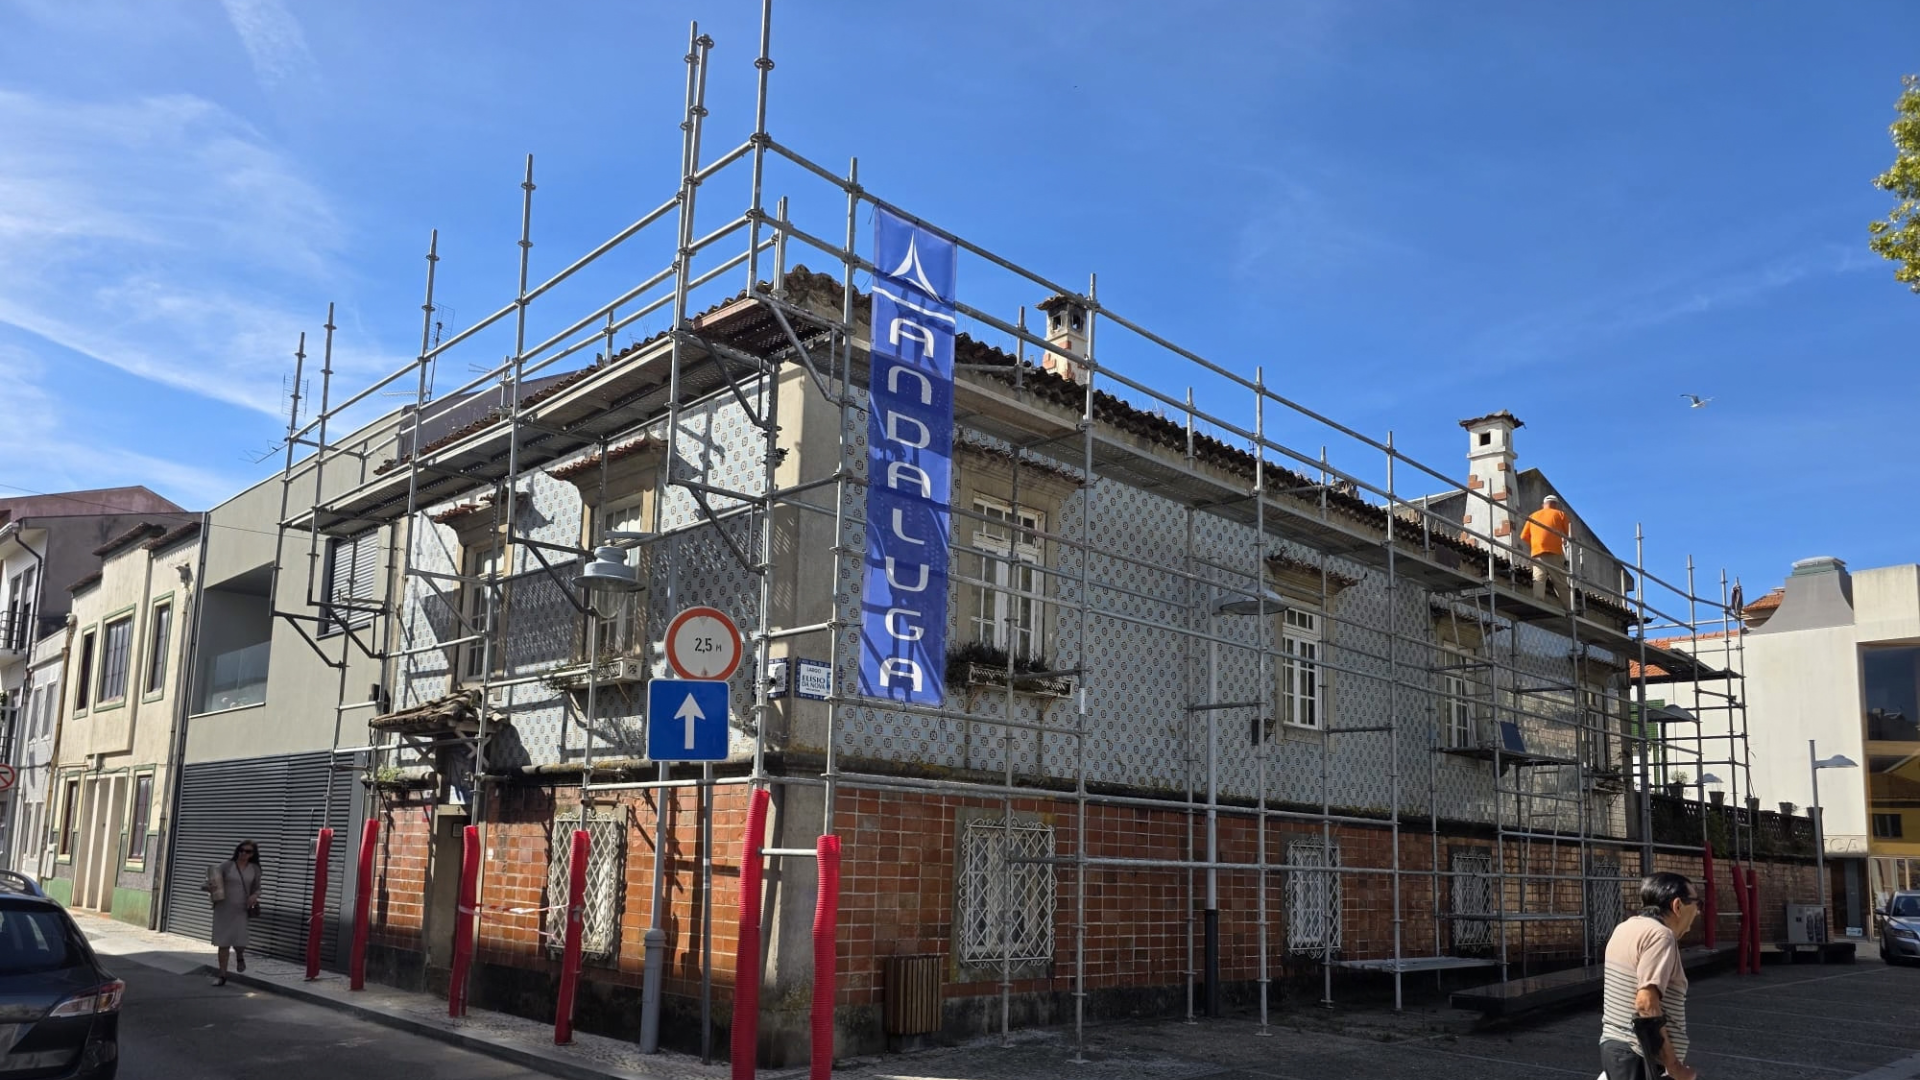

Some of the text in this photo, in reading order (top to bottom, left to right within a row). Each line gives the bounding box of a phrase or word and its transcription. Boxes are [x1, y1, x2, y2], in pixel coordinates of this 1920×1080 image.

[880, 317, 934, 692] ANDALUGA
[695, 638, 712, 653] 2,5
[806, 666, 821, 675] LARGO
